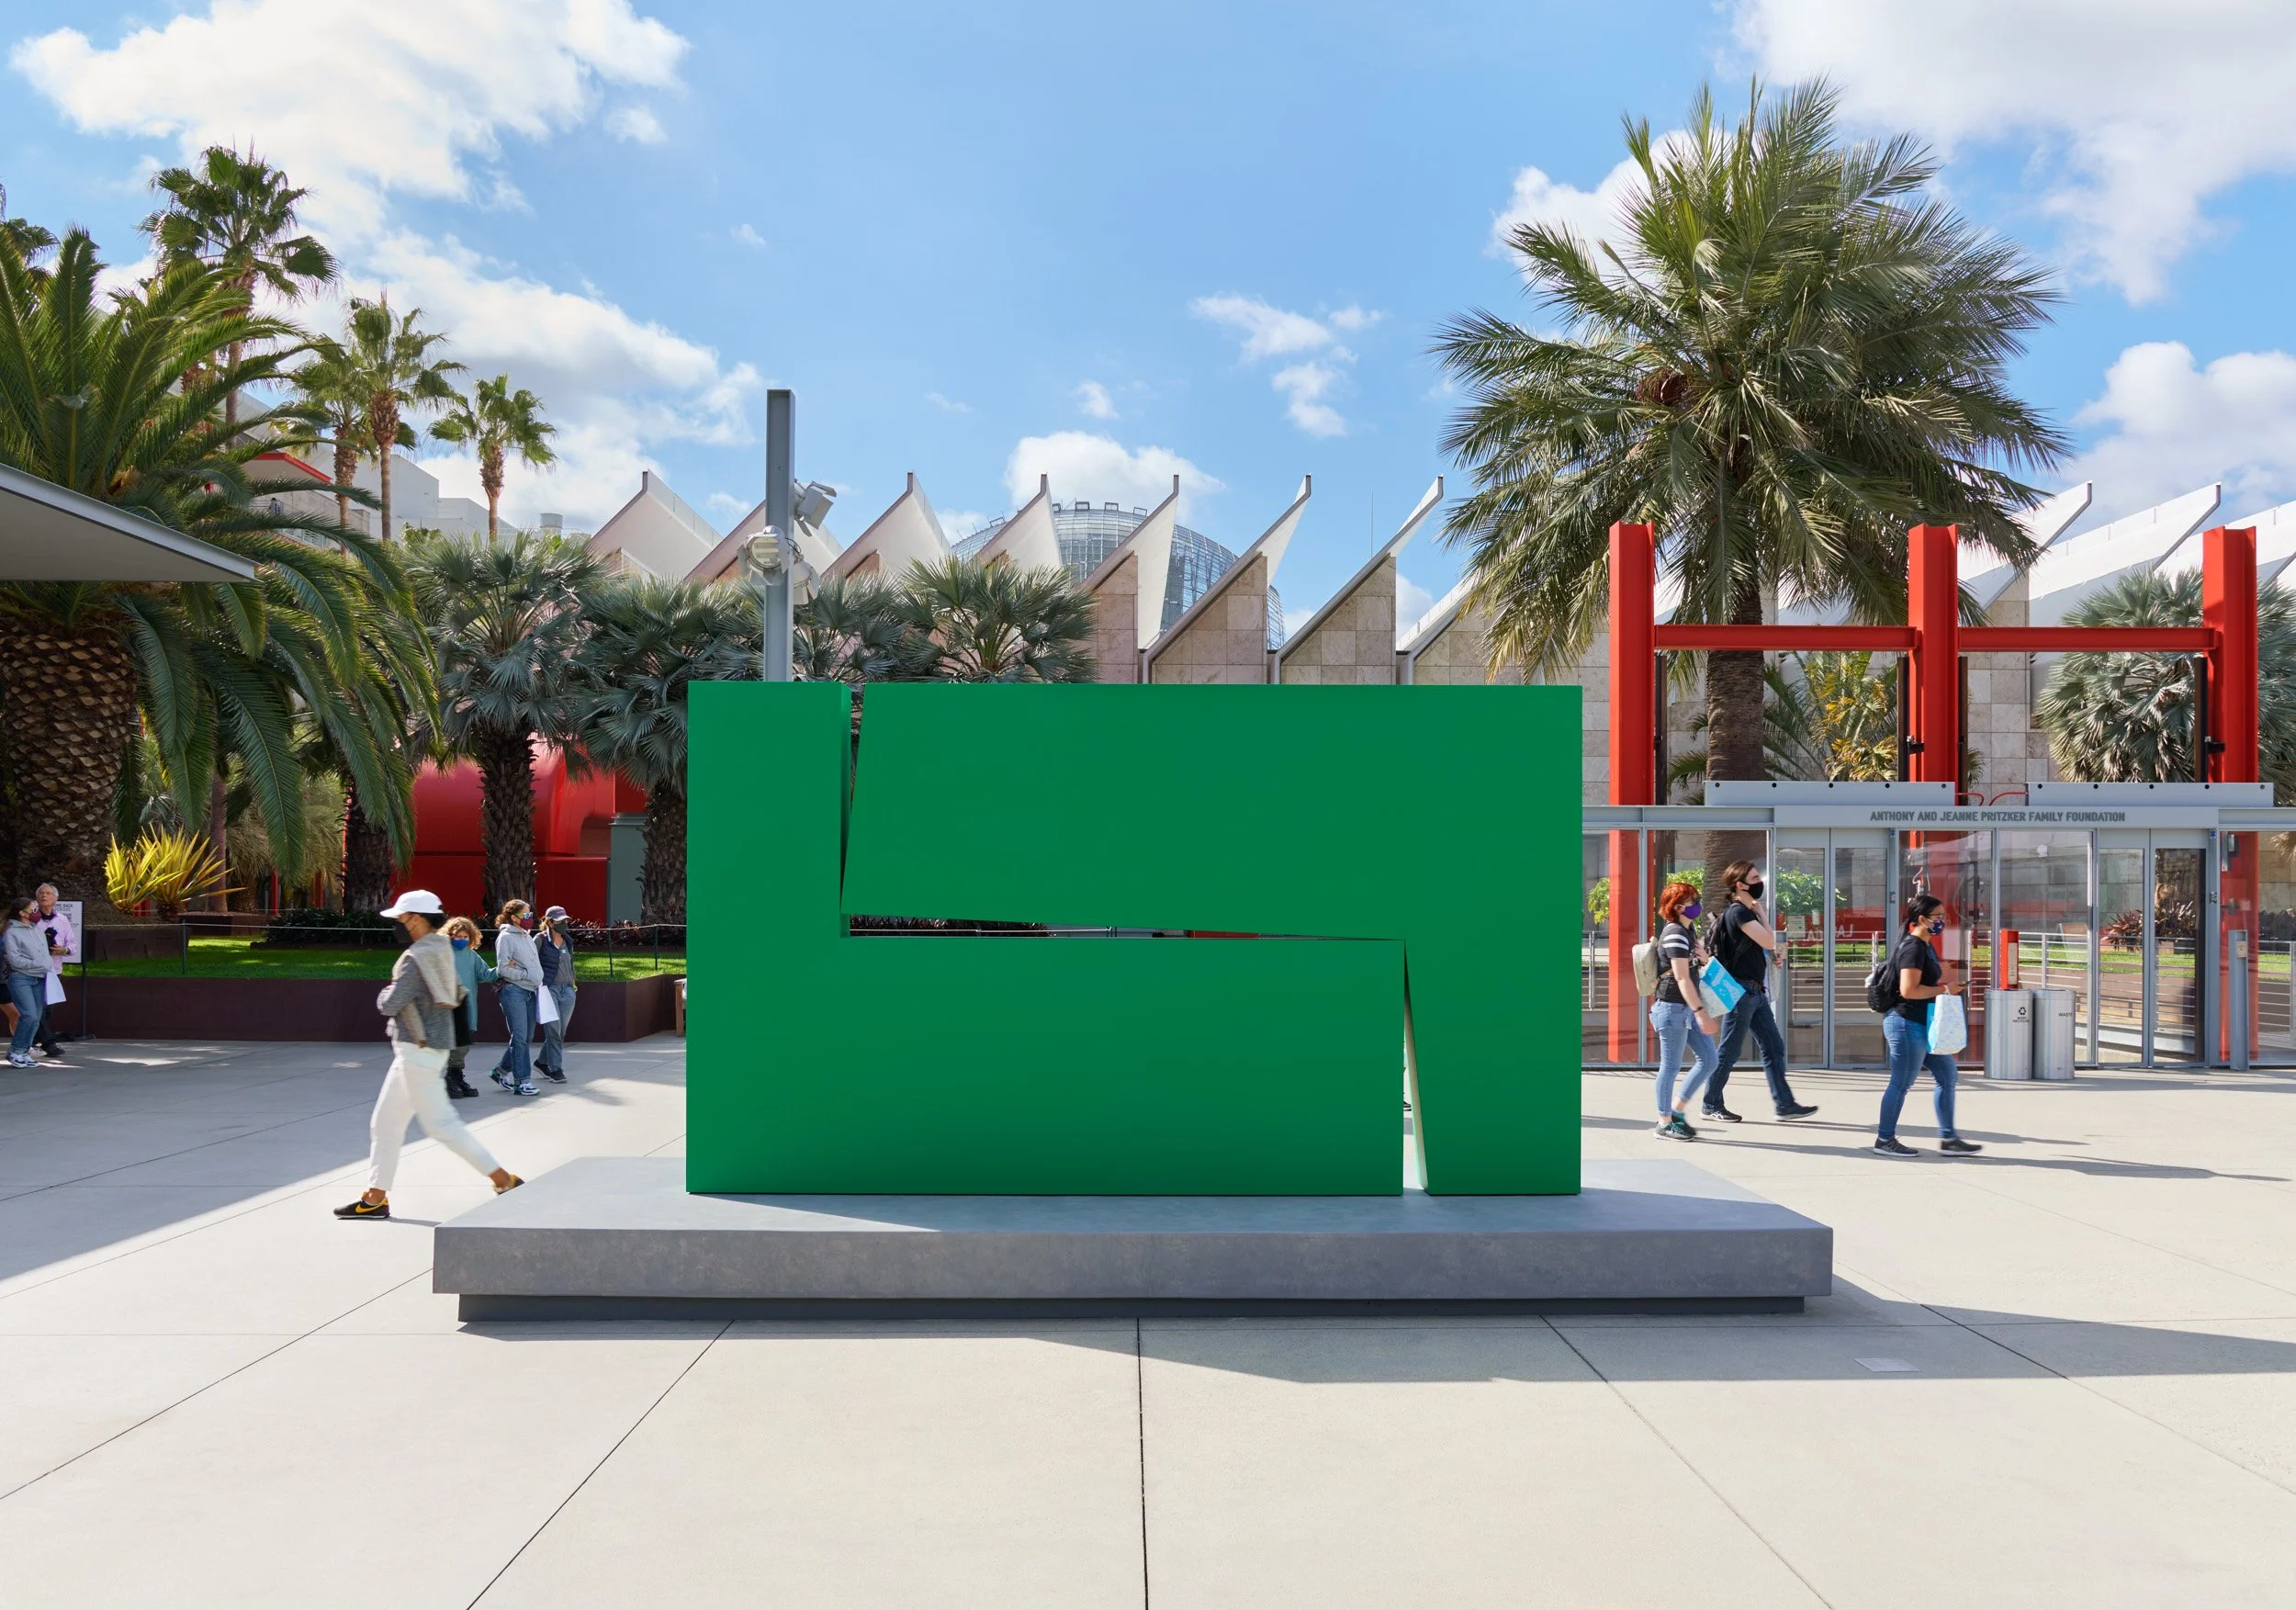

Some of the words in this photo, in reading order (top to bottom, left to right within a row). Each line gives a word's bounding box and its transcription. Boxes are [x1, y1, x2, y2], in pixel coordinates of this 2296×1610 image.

[1870, 811, 1915, 822] ANTHONY
[1918, 811, 1937, 822] AND
[1940, 811, 1978, 822] JEANNE
[1981, 811, 2026, 822] PRITZKER
[2029, 811, 2064, 822] FAMILY
[2066, 811, 2125, 822] FOUNDATION
